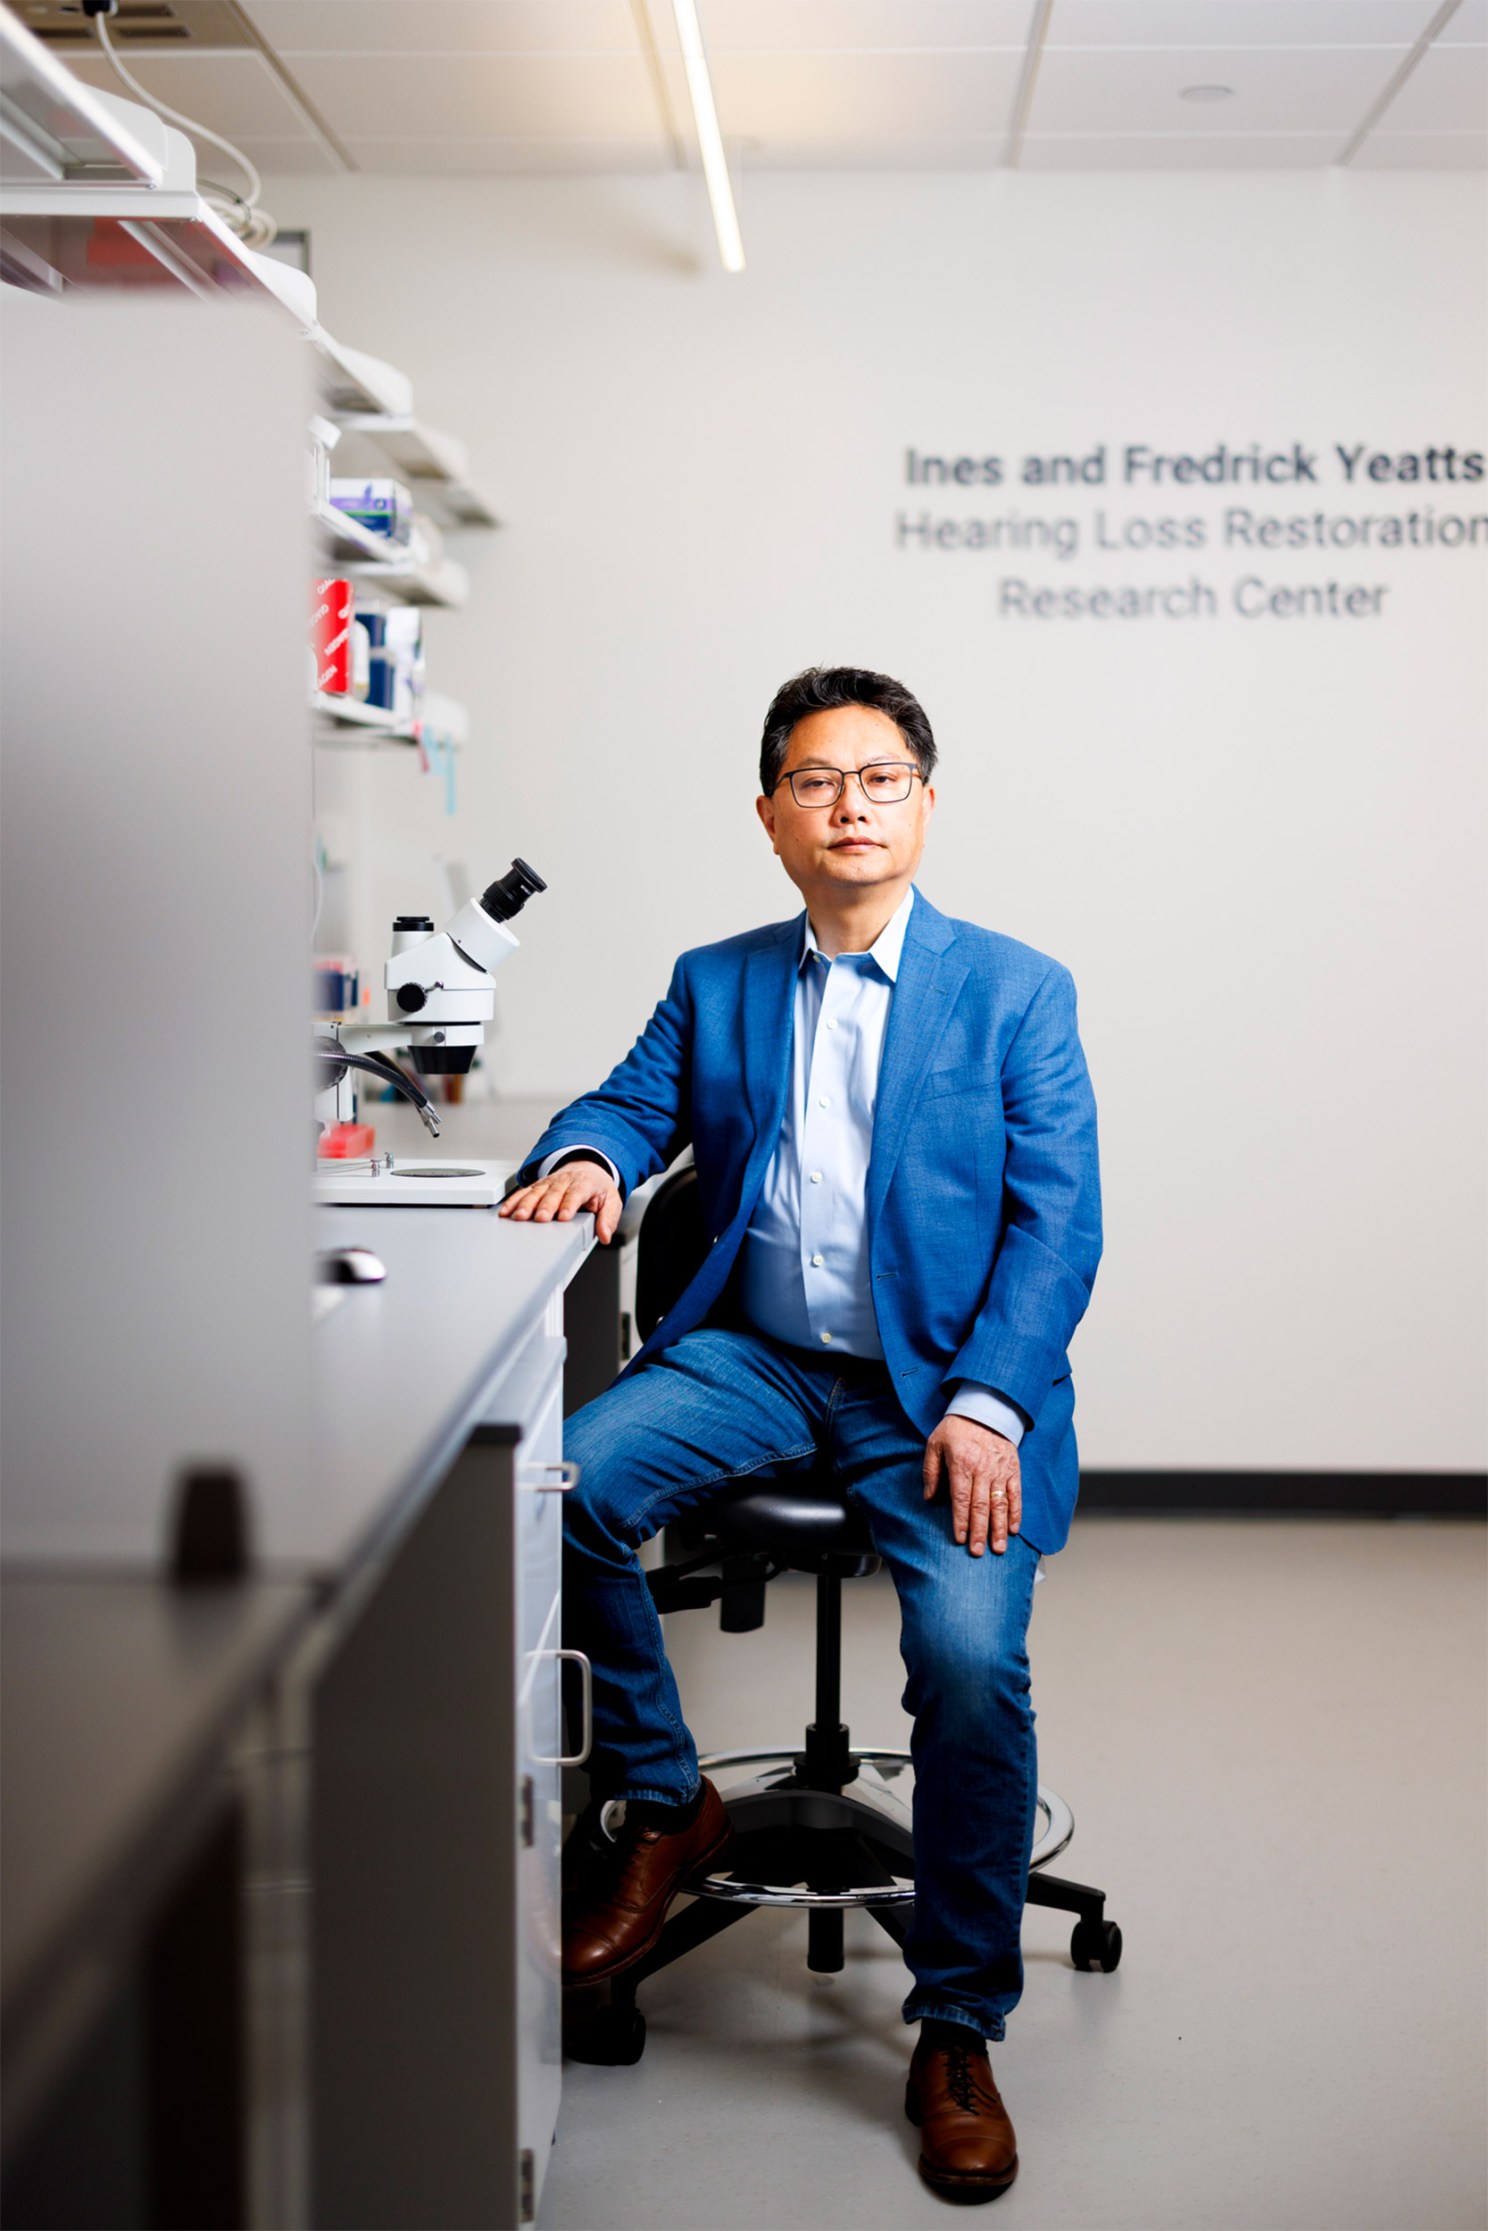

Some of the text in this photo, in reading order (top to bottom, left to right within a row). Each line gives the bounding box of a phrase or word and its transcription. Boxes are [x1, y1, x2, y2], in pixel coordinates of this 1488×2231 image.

[904, 440, 1486, 487] Ines and Fredrick Yeatts
[895, 504, 1488, 560] Hearing Loss Restoration
[998, 575, 1389, 618] Research Center
